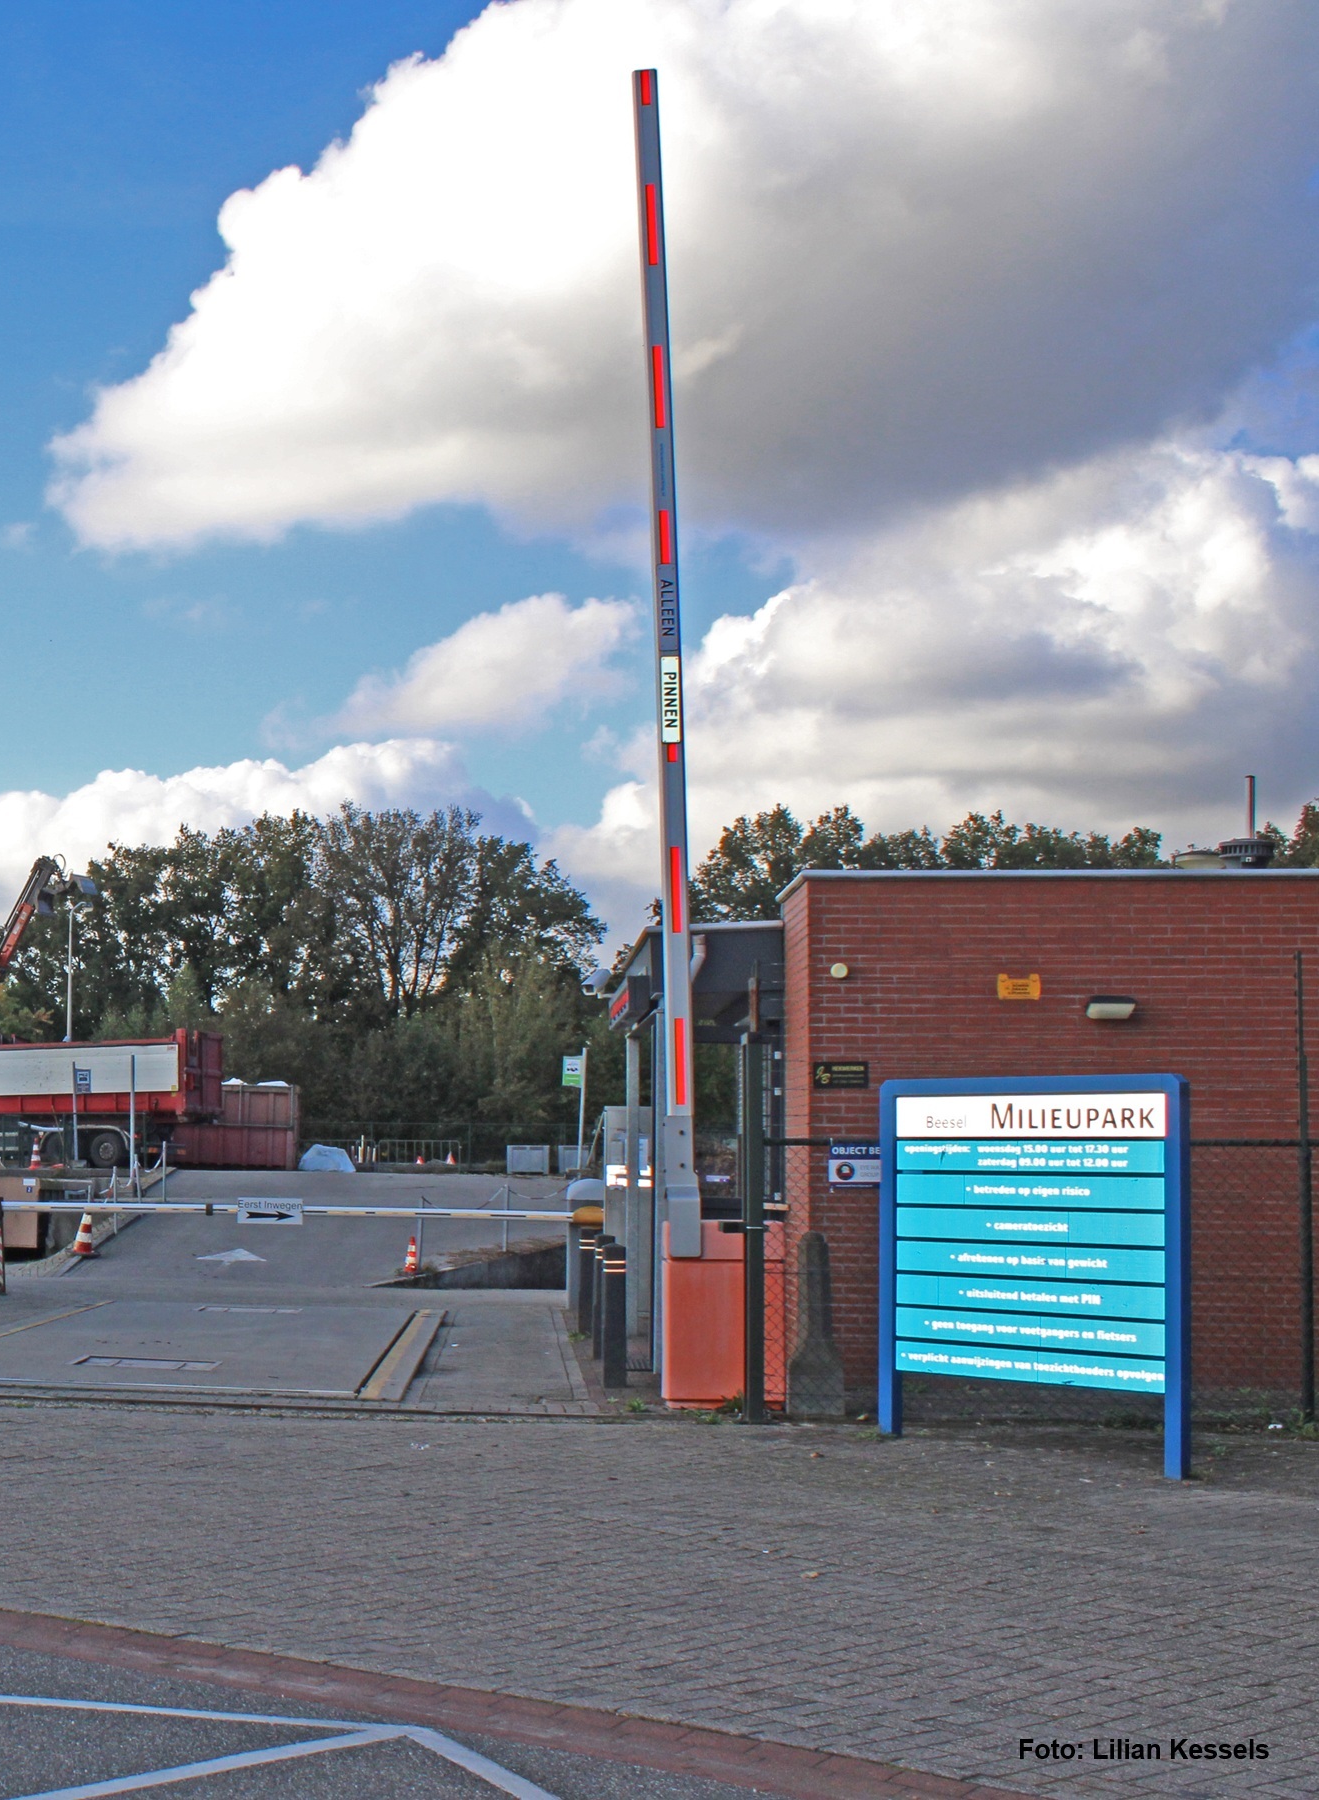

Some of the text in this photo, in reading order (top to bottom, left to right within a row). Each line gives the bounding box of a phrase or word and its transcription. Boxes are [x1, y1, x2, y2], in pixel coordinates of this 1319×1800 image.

[660, 579, 675, 636] ALLEEN
[663, 671, 678, 728] PINNEN
[926, 1103, 1155, 1129] Beesel MILIEUPARK
[831, 1146, 867, 1155] OBJECT
[1068, 1145, 1083, 1153] tot
[977, 1158, 1017, 1168] zaterdag
[1066, 1159, 1081, 1167] tot
[973, 1185, 1091, 1197] betreden op eigen risico
[238, 1200, 302, 1211] Eerst Inwegen
[994, 1222, 1068, 1232] cameratoezicht
[1006, 1256, 1019, 1266] op
[1021, 1255, 1046, 1265] basis
[1048, 1258, 1066, 1266] van
[1067, 1258, 1108, 1269] gewicht
[1020, 1291, 1057, 1302] betalen
[1059, 1295, 1079, 1304] met
[1081, 1294, 1101, 1305] PIN
[931, 1321, 1137, 1342] geen toegang voor voetgangers en fietsers
[908, 1352, 949, 1364] verplicht
[1014, 1361, 1031, 1370] van
